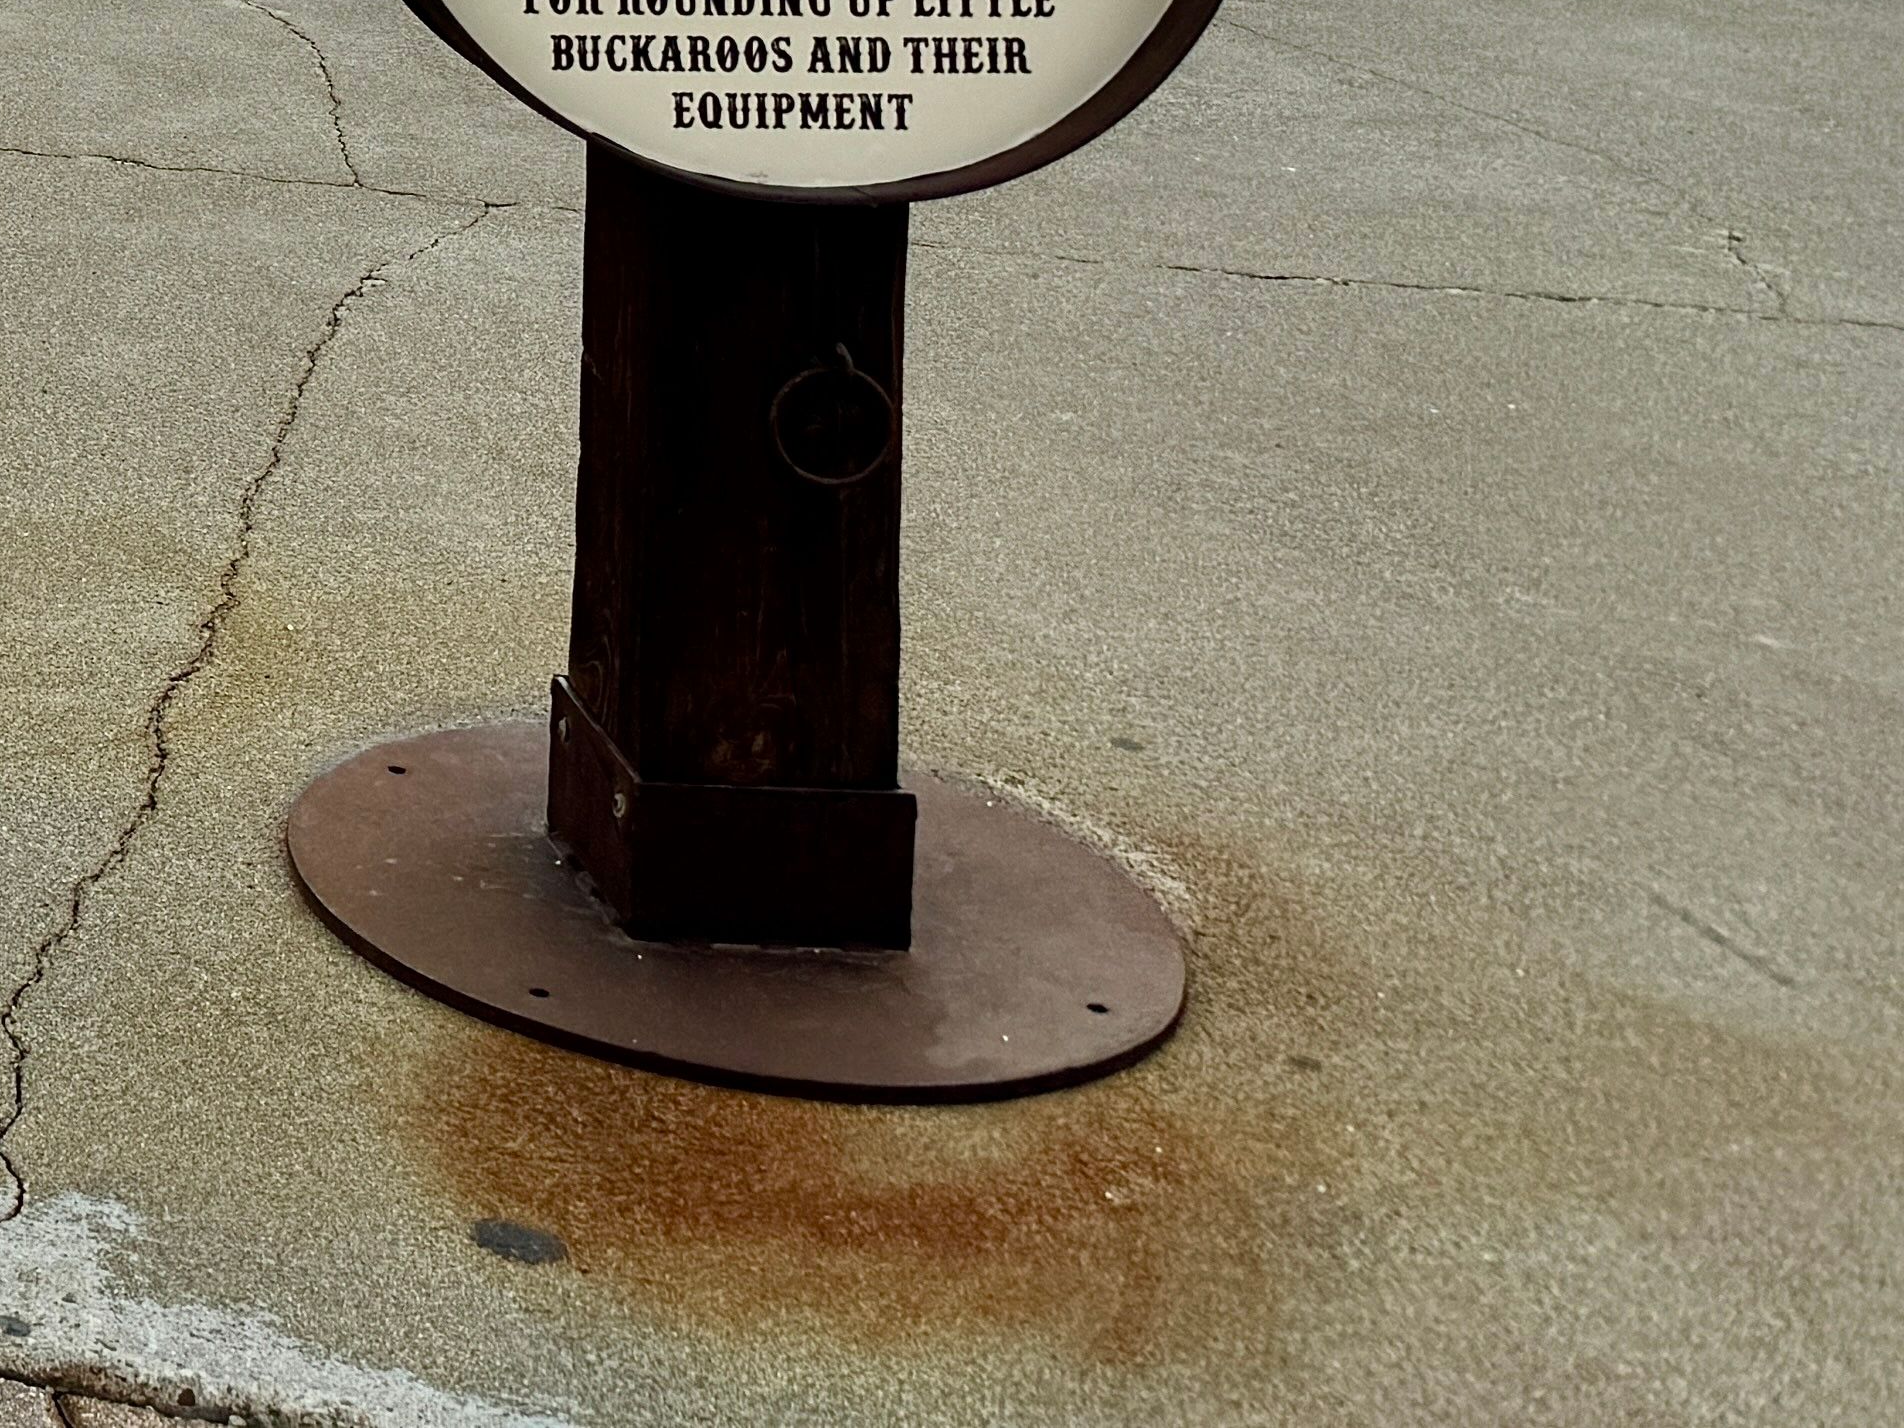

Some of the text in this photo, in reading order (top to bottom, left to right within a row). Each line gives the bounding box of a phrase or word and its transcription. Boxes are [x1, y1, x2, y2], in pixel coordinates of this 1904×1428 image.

[550, 35, 1033, 75] BUCKAROOS AND THEIR
[671, 92, 914, 131] EQUIPMENT
